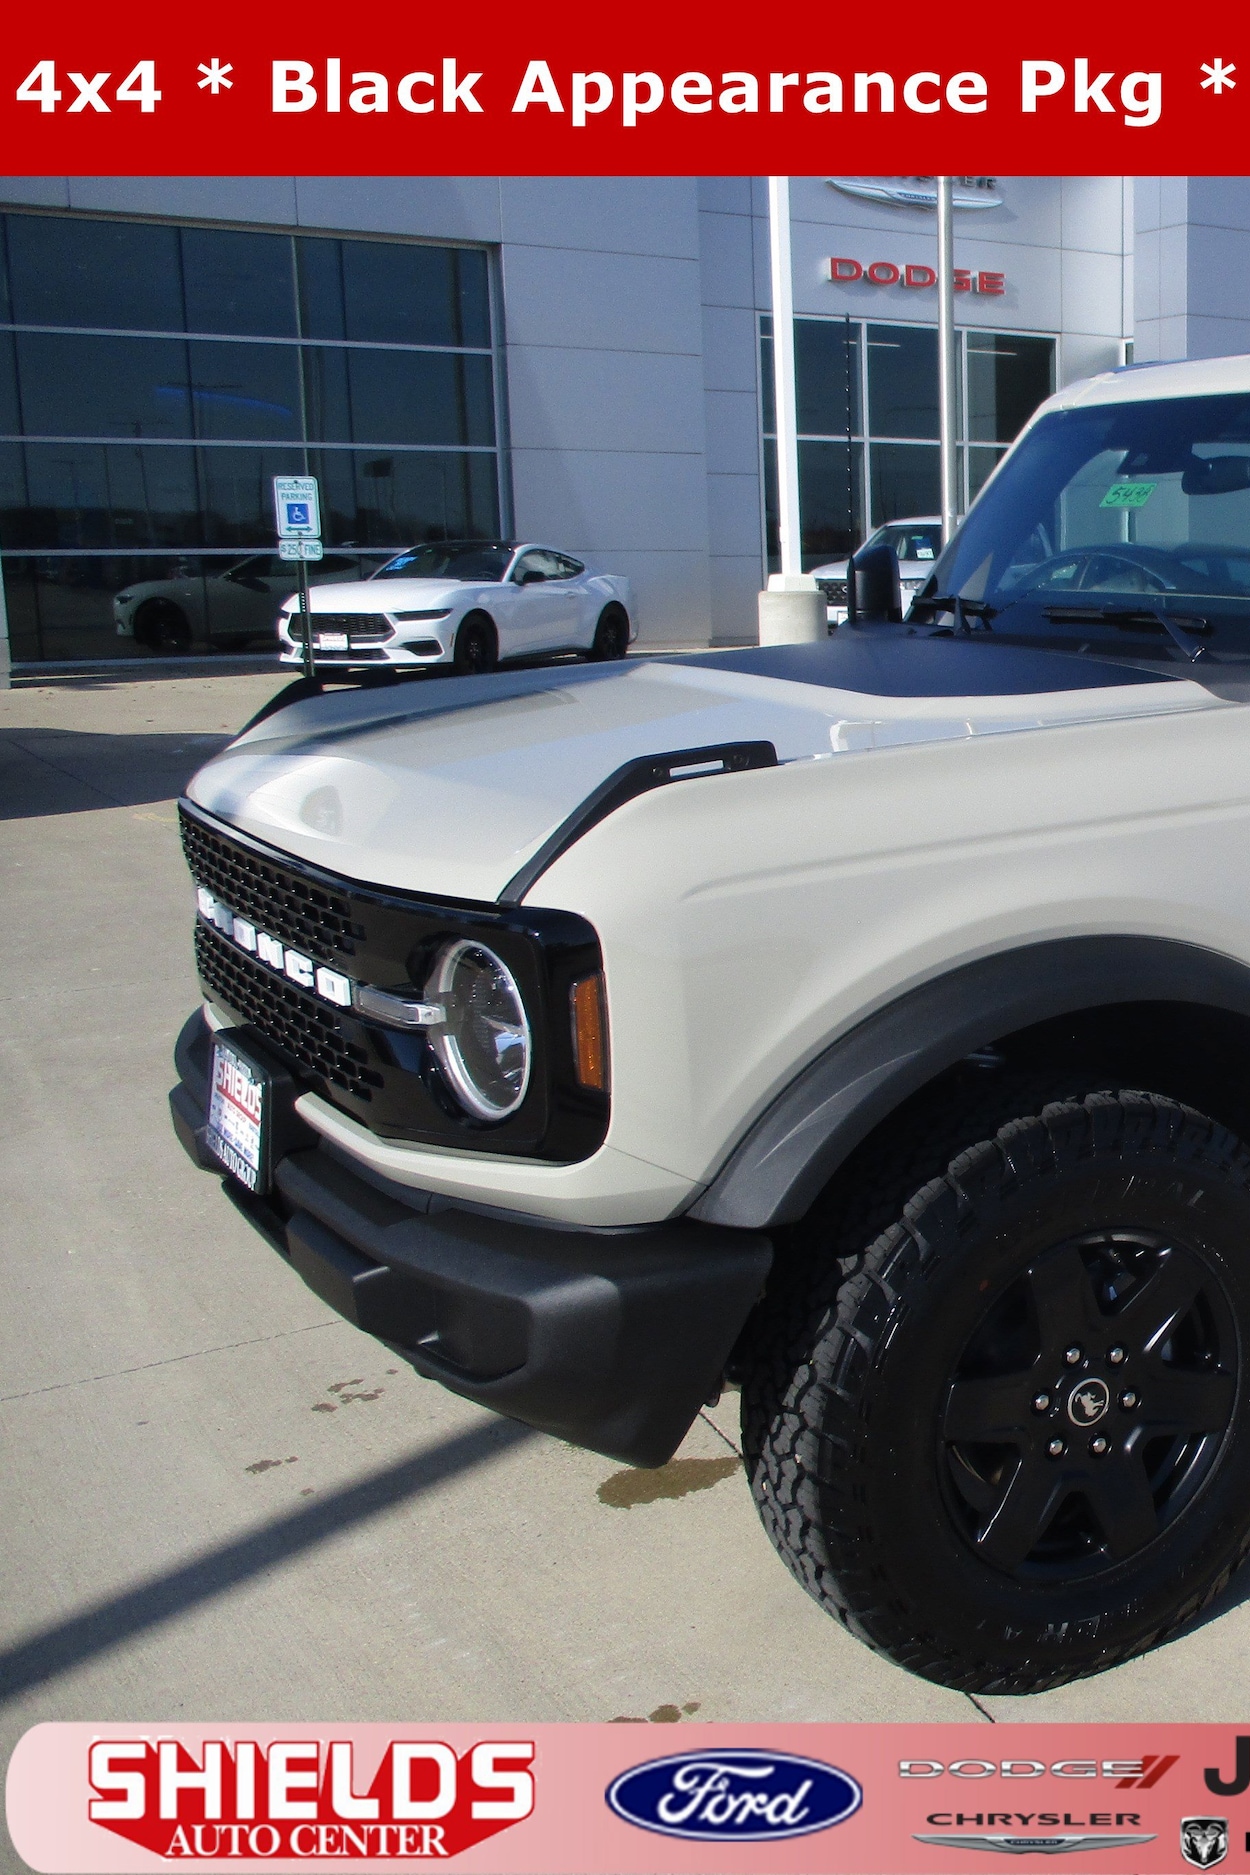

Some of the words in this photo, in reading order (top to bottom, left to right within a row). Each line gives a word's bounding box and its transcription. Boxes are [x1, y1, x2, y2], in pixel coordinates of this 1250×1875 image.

[829, 257, 1006, 295] DODGE
[278, 482, 314, 491] RESERVED
[281, 493, 313, 501] PARKING
[304, 544, 321, 555] FINE
[197, 886, 353, 1008] BRONCO
[214, 1057, 262, 1119] SHIELDS
